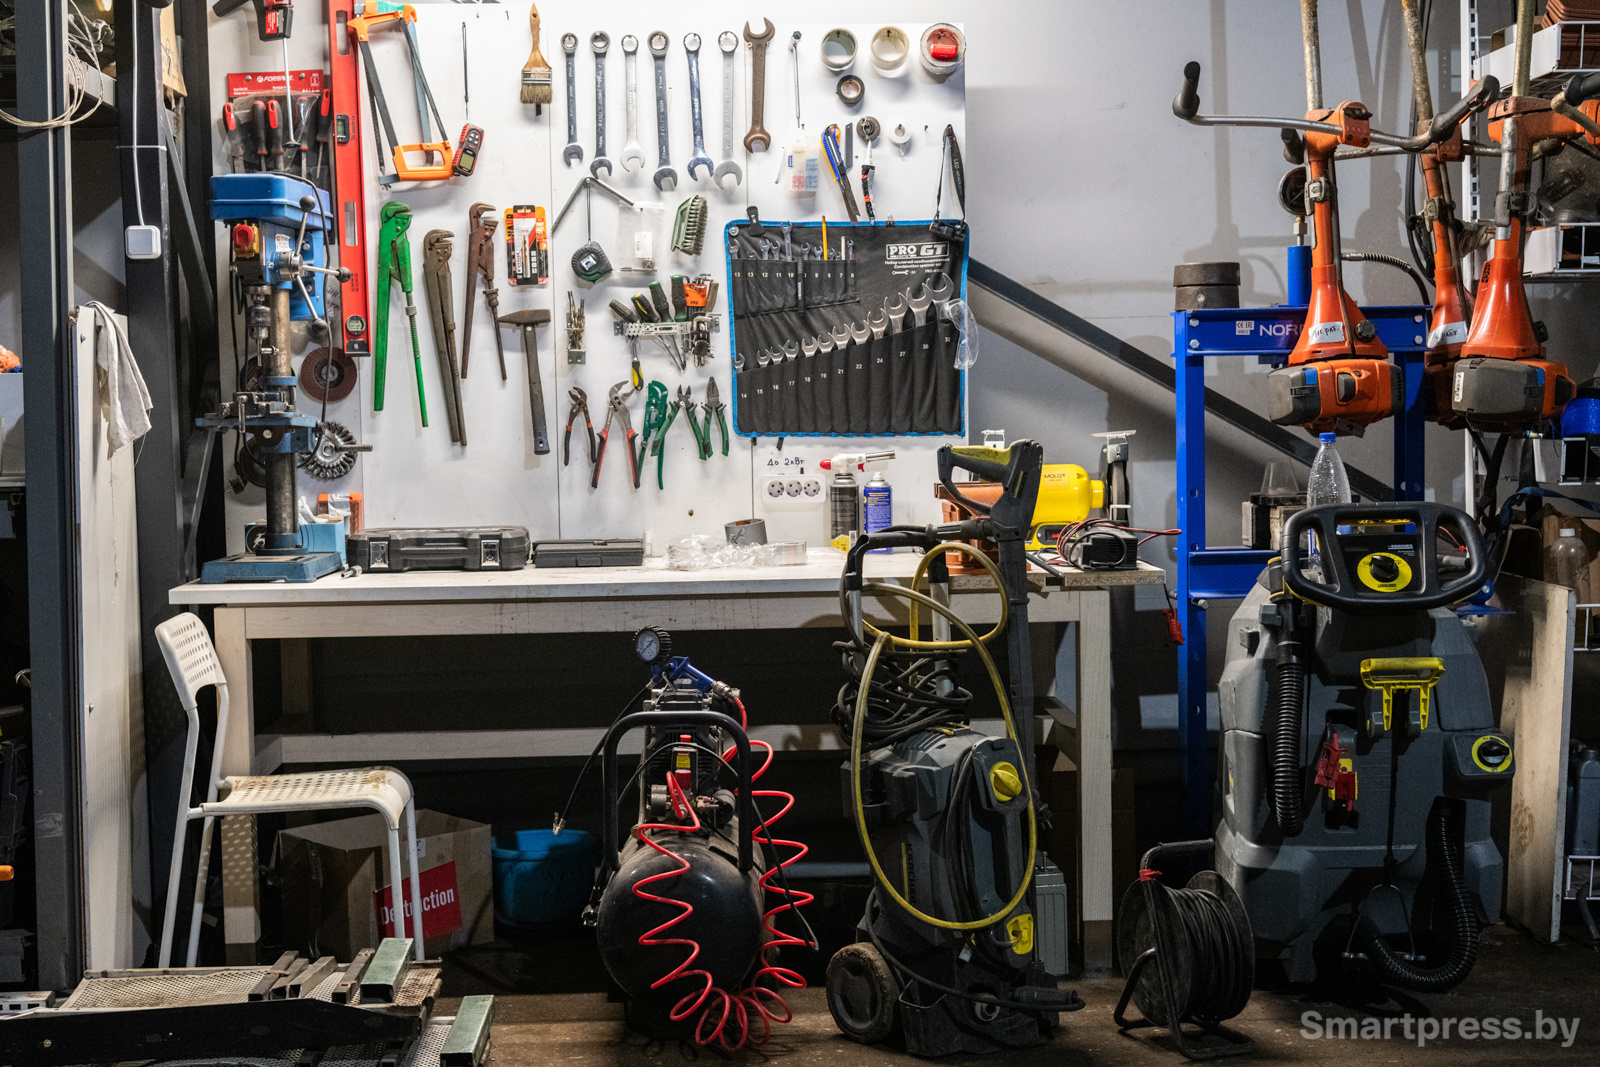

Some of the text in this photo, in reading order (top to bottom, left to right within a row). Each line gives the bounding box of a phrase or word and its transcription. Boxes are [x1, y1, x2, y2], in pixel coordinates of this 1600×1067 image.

[889, 244, 946, 256] PRO GT
[767, 458, 779, 466] До
